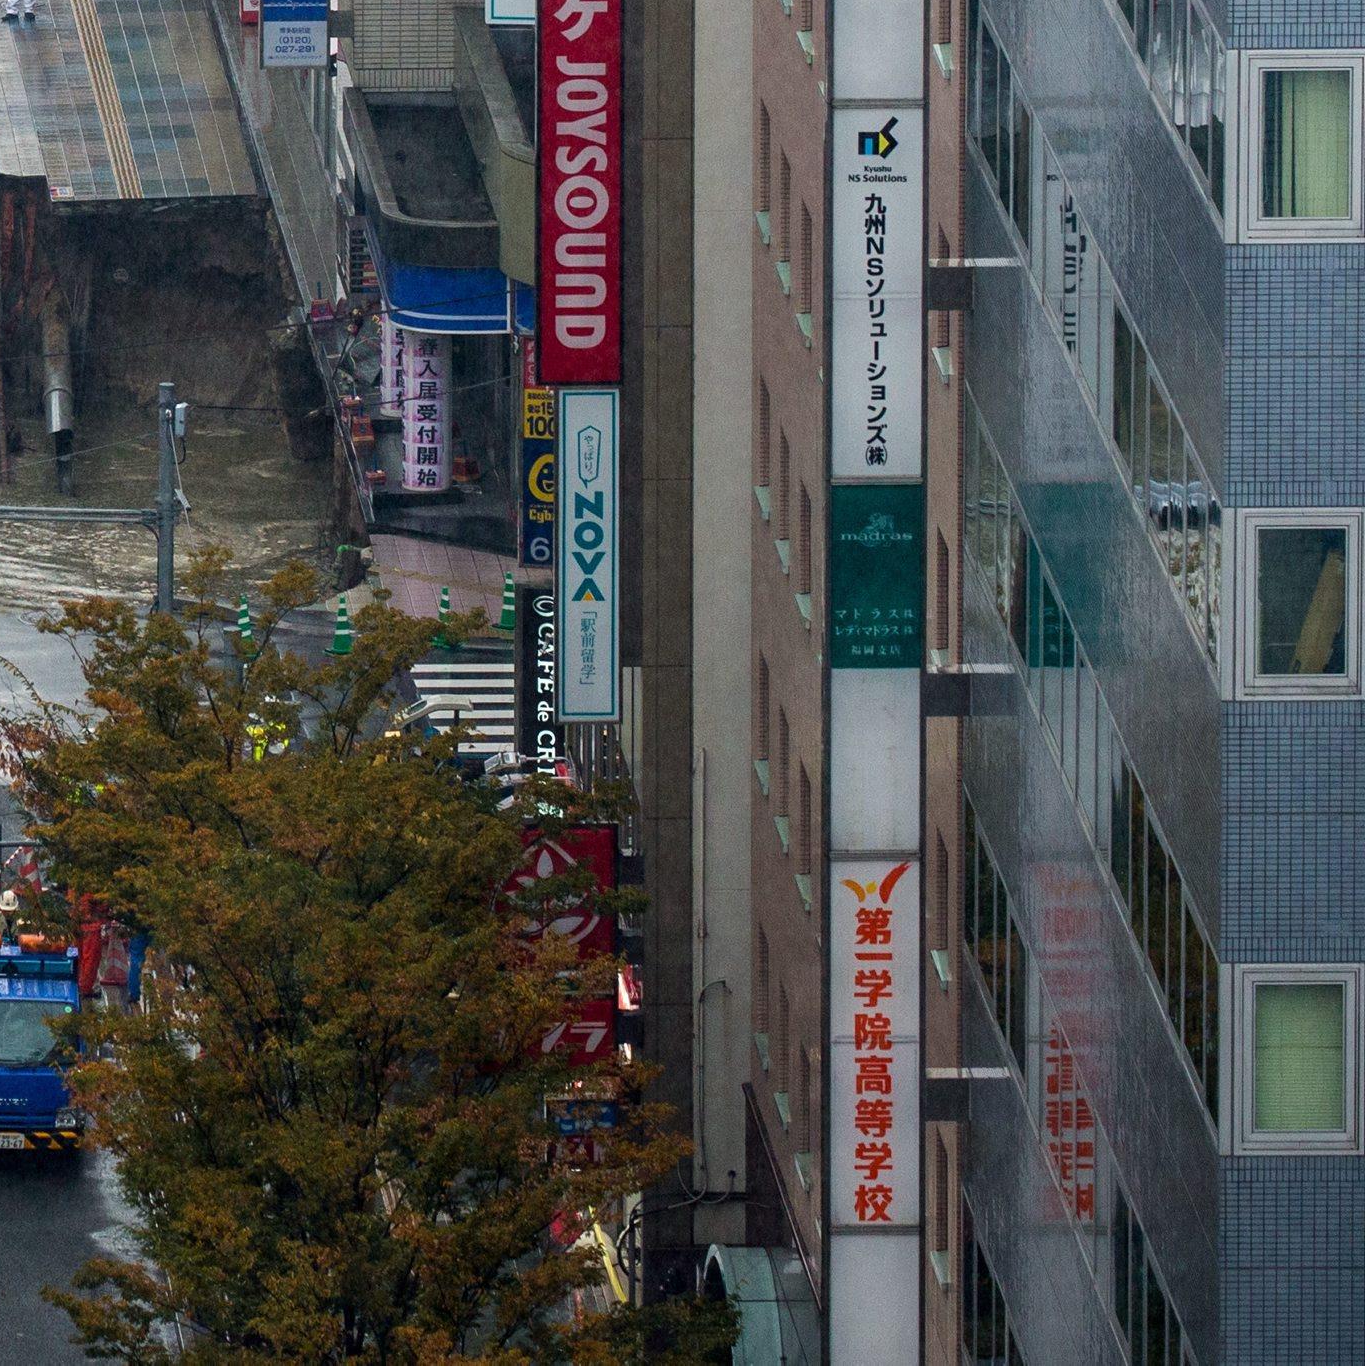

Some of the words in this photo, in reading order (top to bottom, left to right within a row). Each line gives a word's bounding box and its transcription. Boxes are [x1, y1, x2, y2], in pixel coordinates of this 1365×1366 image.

[279, 36, 312, 45] (0120)
[275, 45, 316, 53] 027-291
[864, 165, 892, 173] Kyushu
[848, 174, 861, 183] NS
[863, 174, 908, 183] Solutions
[554, 55, 610, 349] JOYSOUND
[840, 530, 913, 541] madras
[571, 491, 606, 602] NOVA
[537, 700, 555, 722] de
[853, 907, 894, 1222] 第一学院高等学校
